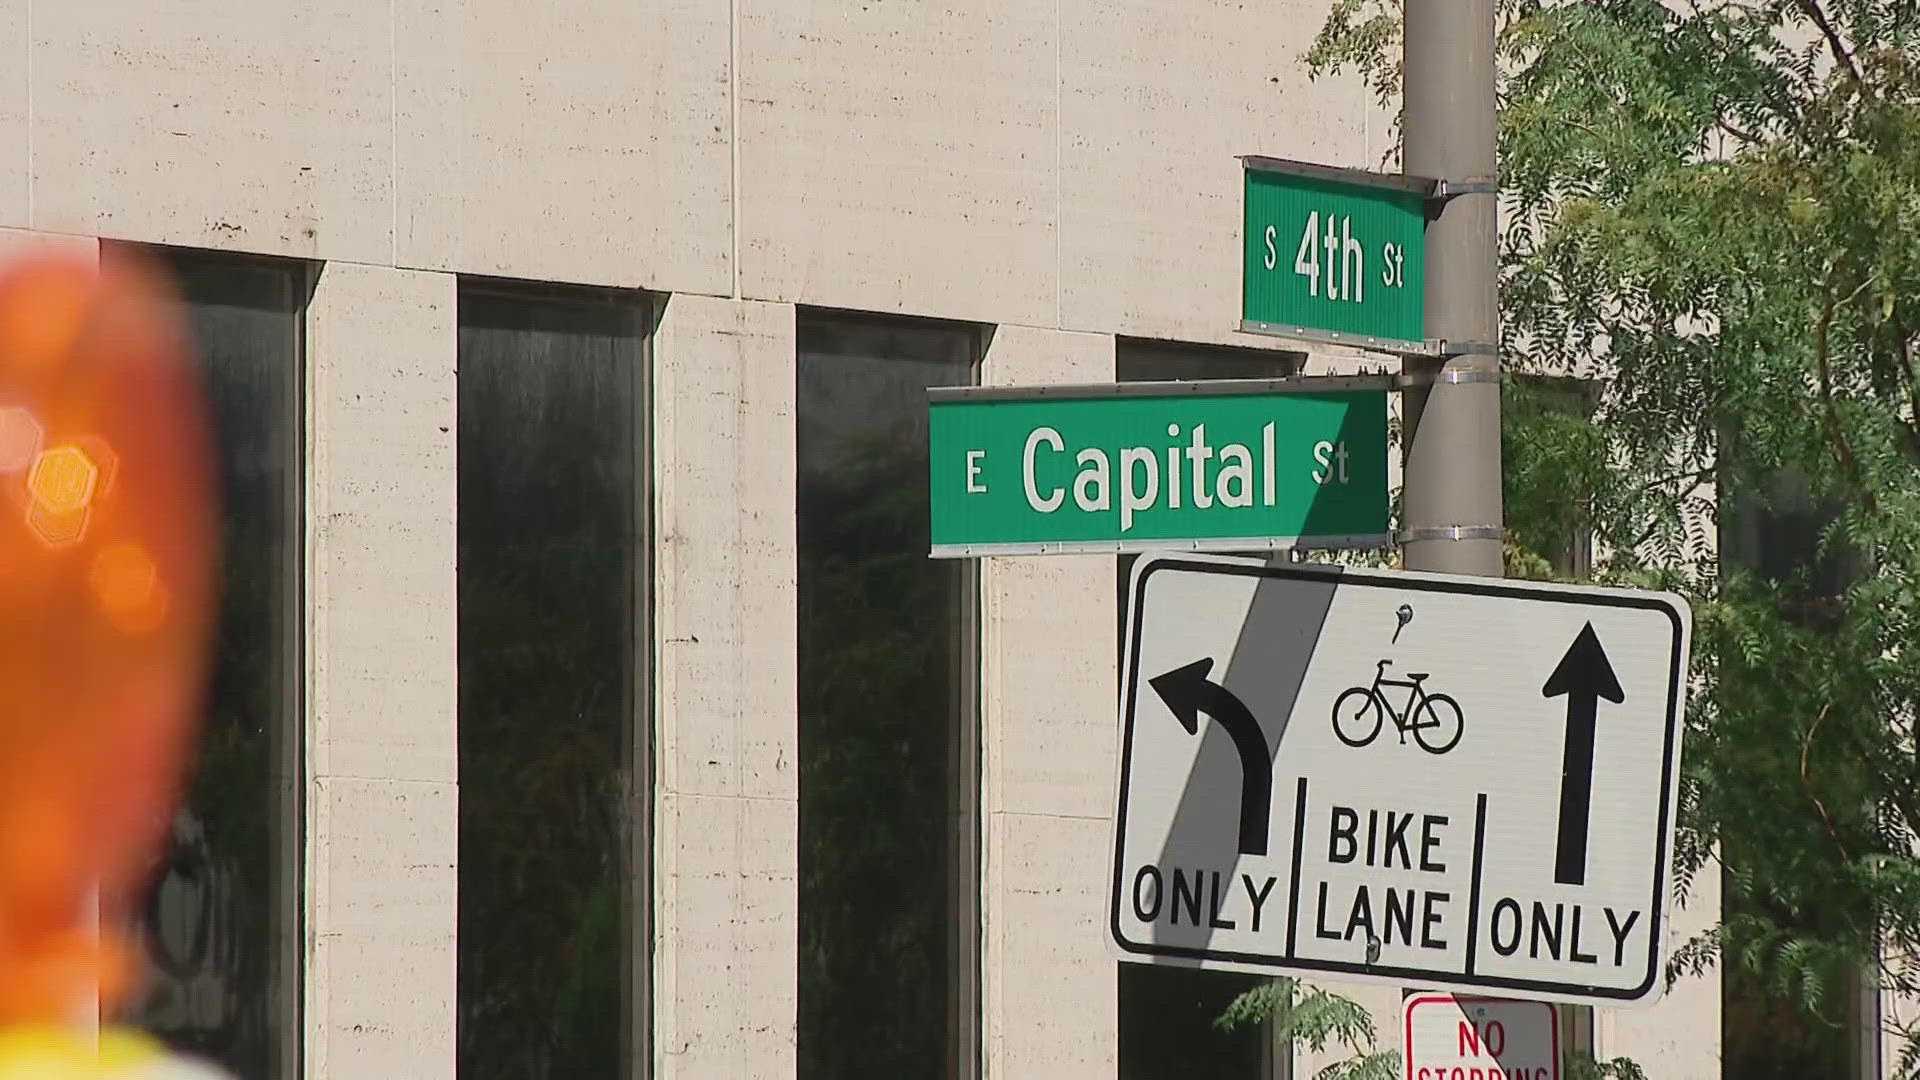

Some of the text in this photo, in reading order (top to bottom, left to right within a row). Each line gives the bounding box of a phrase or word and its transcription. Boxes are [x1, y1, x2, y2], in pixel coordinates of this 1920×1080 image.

[1264, 211, 1403, 303] S 4th St
[966, 420, 1349, 532] E Capital St
[1328, 806, 1449, 873] BIKE
[1132, 864, 1277, 932] ONLY
[1316, 881, 1450, 950] LANE
[1491, 897, 1641, 967] ONLY
[1459, 1021, 1505, 1057] NO
